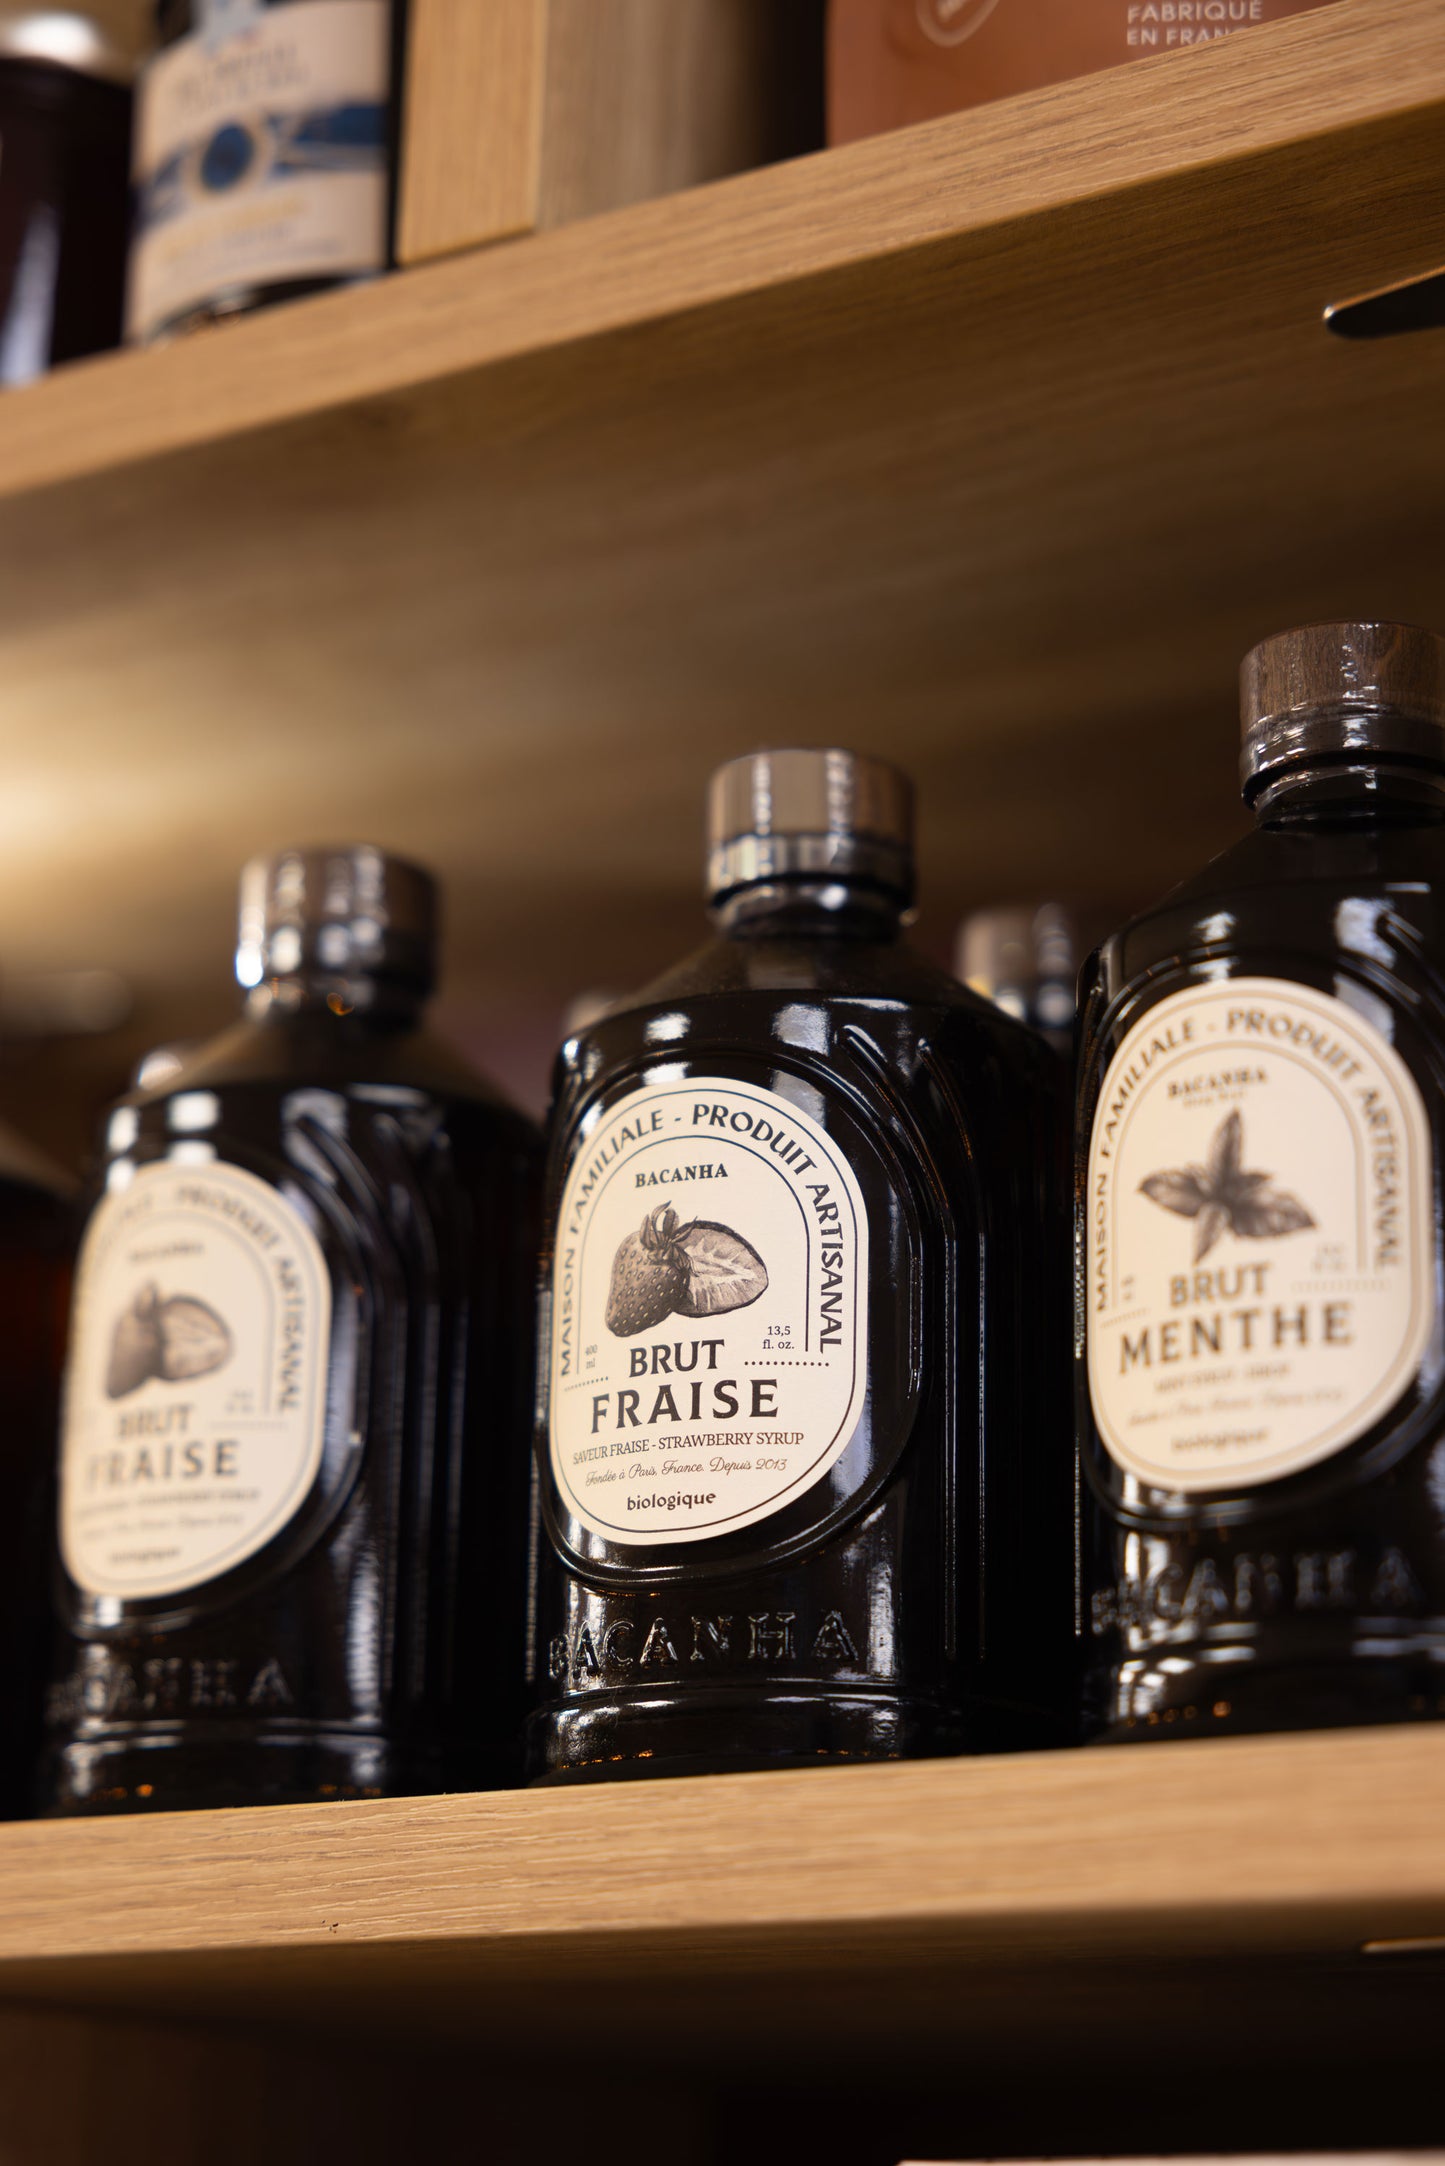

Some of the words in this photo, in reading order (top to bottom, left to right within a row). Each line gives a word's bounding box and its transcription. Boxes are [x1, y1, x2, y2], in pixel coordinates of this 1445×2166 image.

[1126, 27, 1158, 46] EN
[1166, 27, 1248, 46] FRAN
[1226, 1008, 1362, 1081] PRODUIT
[1101, 1018, 1196, 1158] FAMILIALE
[635, 1163, 729, 1188] BACANHA
[1358, 1089, 1402, 1268] ARTISANAL
[561, 1248, 575, 1377] MAISON
[569, 1109, 664, 1235] FAMILIALE
[692, 1104, 818, 1176] PRODUIT
[805, 1183, 843, 1354] ARTISANAL
[1096, 1173, 1107, 1312] MAISON
[1169, 1262, 1270, 1308] BRUT
[762, 1339, 774, 1349] fl.
[778, 1341, 795, 1349] oz.
[768, 1326, 791, 1336] 13,5
[1119, 1302, 1354, 1375] MENTHE
[628, 1339, 725, 1378] BRUT
[590, 1379, 778, 1434] FRAISE
[85, 1439, 239, 1493] FRAISE
[573, 1445, 608, 1465] SAVEUR
[610, 1439, 650, 1456] FRAISE
[658, 1433, 753, 1450] STRAWBERRY
[756, 1432, 804, 1445] SYRUP
[585, 1469, 617, 1487] Fondée
[709, 1457, 752, 1475] Depuis
[755, 1458, 787, 1471] 2013
[627, 1491, 717, 1511] biologique
[548, 1610, 859, 1680] BACANHA
